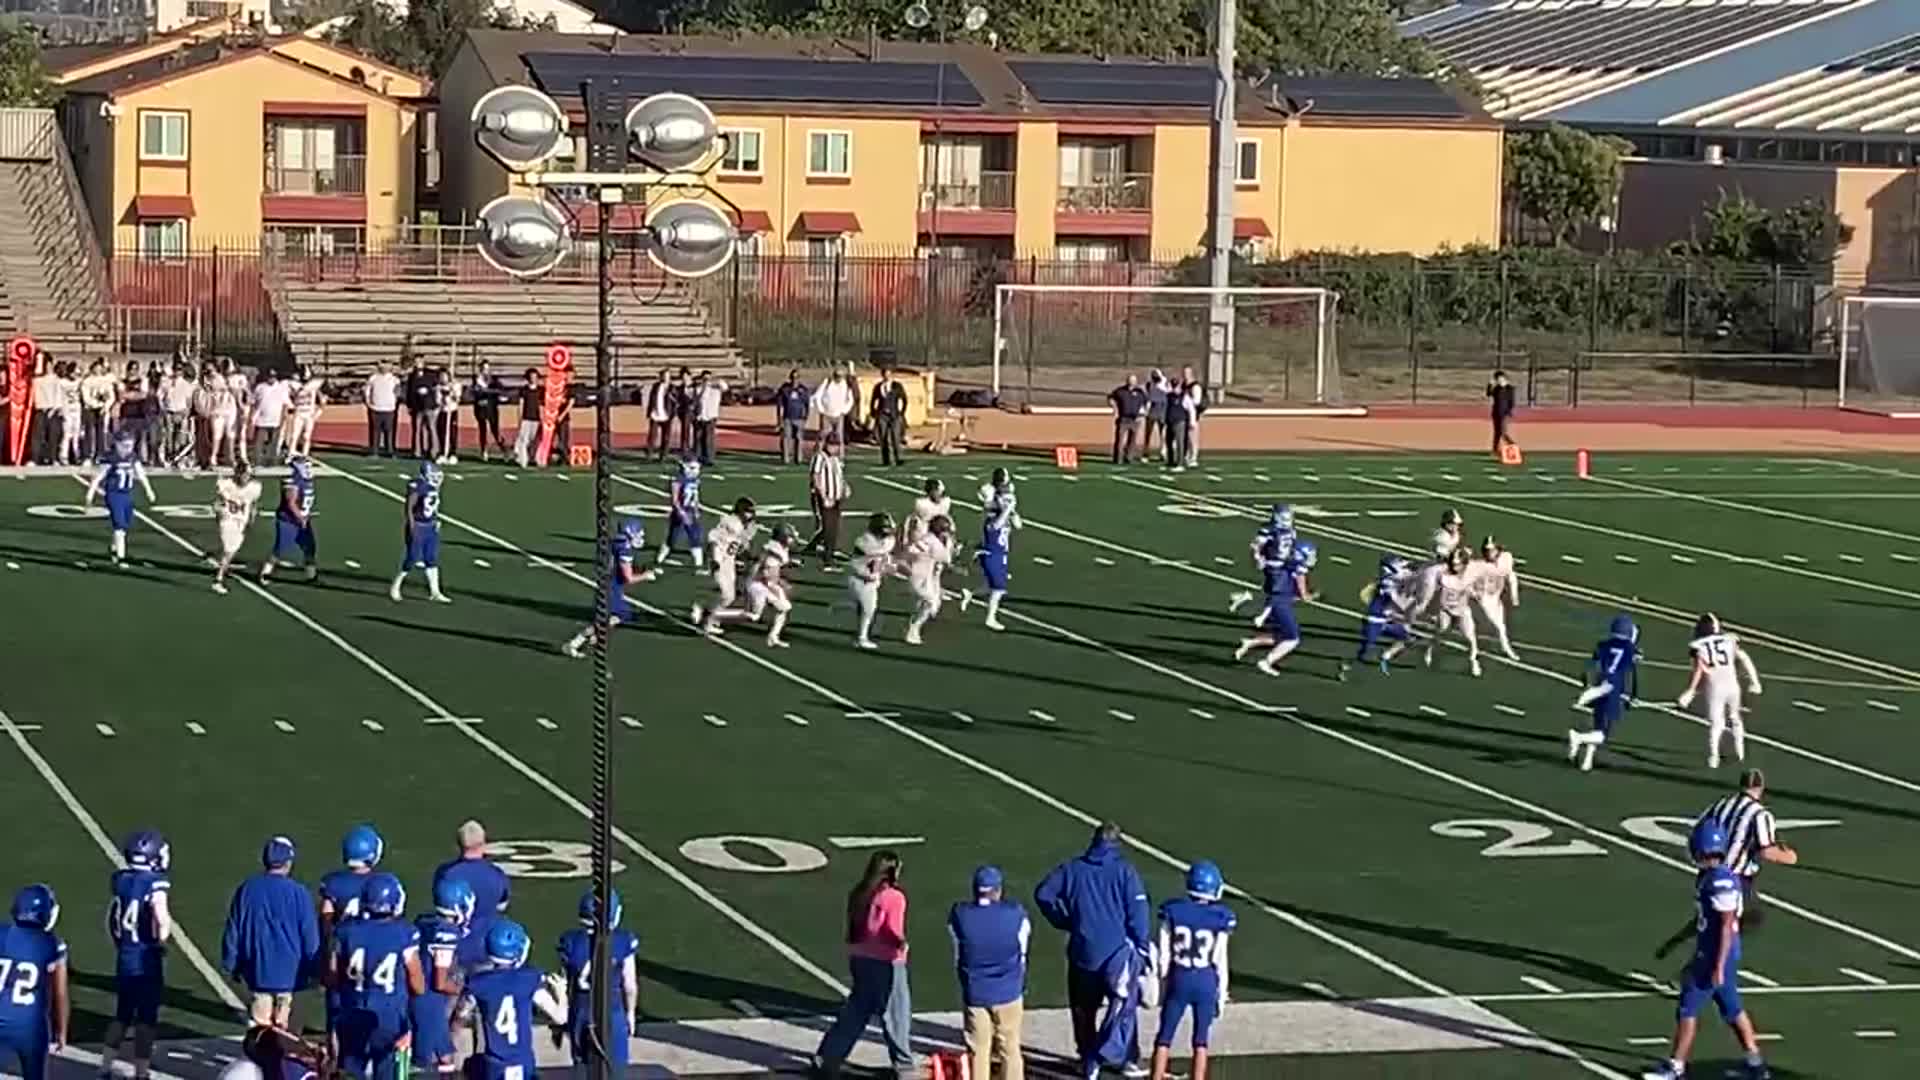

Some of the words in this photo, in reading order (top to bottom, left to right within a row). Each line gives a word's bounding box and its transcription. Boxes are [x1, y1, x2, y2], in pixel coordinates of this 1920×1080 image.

[1609, 648, 1624, 673] 7
[1703, 639, 1728, 667] 15
[1174, 926, 1213, 968] 23
[0, 957, 38, 1005] 72
[346, 947, 398, 993] 44
[495, 994, 518, 1045] 4
